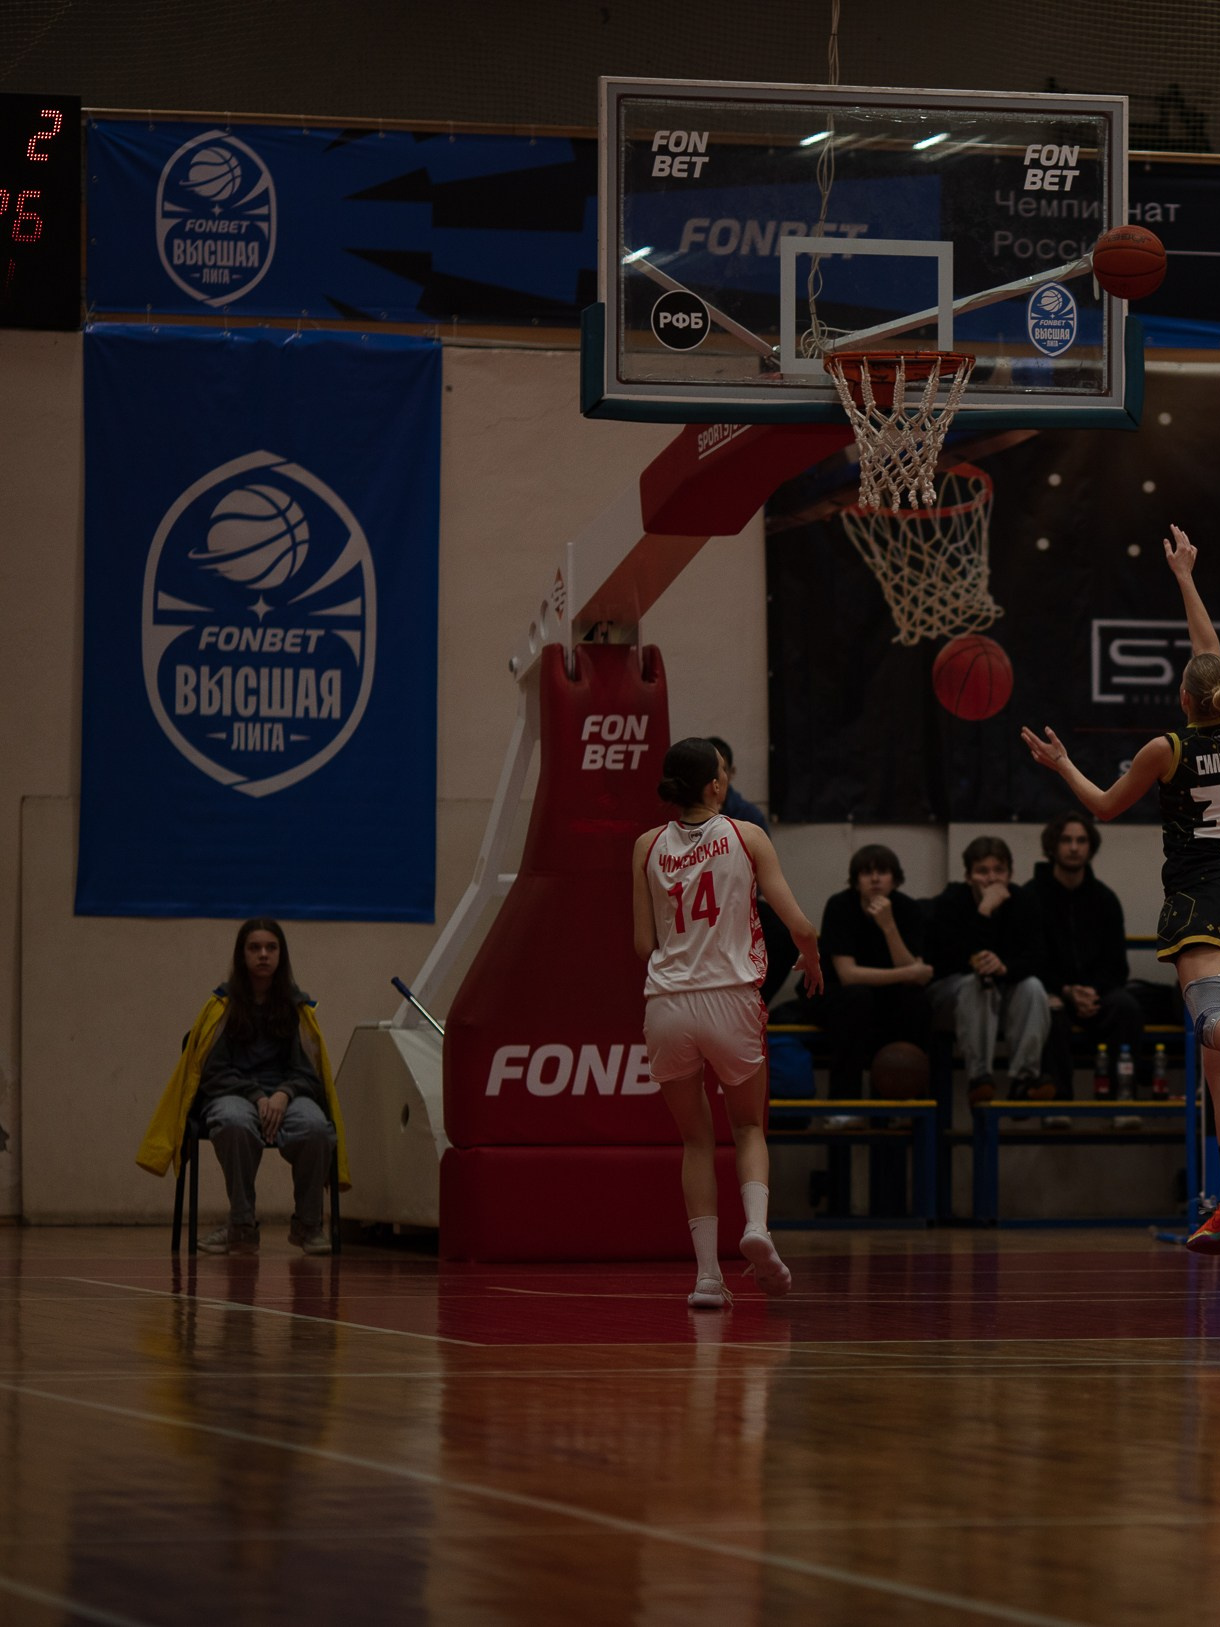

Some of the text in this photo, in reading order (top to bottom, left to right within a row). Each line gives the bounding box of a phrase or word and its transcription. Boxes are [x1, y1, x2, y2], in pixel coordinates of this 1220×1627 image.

[27, 109, 64, 161] 2
[652, 131, 709, 153] FON
[652, 155, 709, 179] BET
[1024, 144, 1080, 167] FON
[1023, 168, 1080, 192] BET
[995, 189, 1182, 223] Чемпинат
[185, 219, 250, 235] FONBET
[172, 239, 259, 269] ВЫСШАЯ
[201, 268, 231, 285] ЛИГА
[658, 310, 704, 331] РФБ
[1035, 328, 1070, 340] ВЫСШАЯ
[199, 624, 325, 655] FONBET
[174, 664, 342, 720] ВЫСШАЯ
[230, 720, 285, 753] ЛИГА
[581, 713, 649, 740] FON
[581, 743, 649, 771] BET
[668, 871, 720, 934] 14
